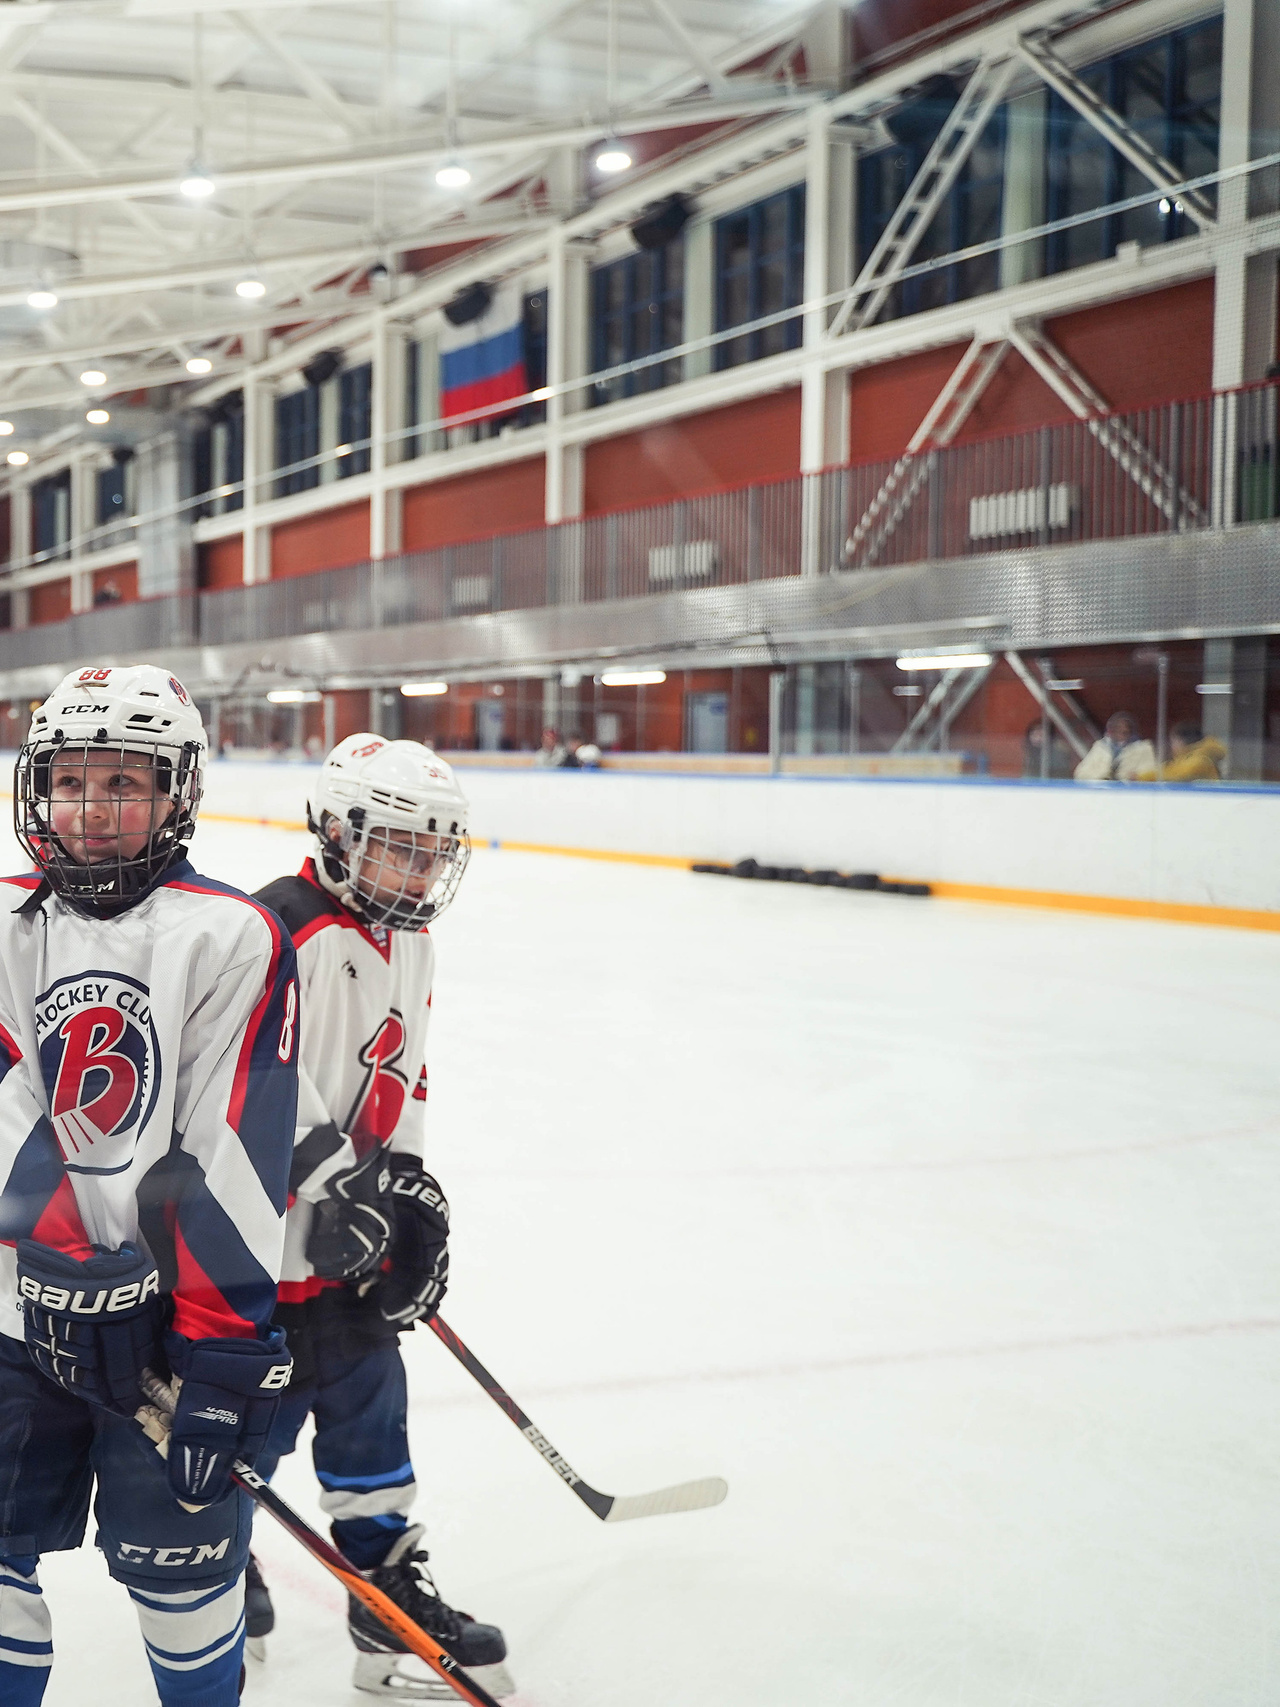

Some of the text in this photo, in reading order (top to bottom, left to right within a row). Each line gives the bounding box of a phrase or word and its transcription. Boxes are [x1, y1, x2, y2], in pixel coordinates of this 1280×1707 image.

[78, 669, 112, 681] 88
[61, 704, 110, 715] CCM
[35, 984, 110, 1036] HOCKEY
[20, 1268, 160, 1315] BAUER
[524, 1423, 581, 1487] BAUER
[116, 1538, 232, 1568] CCM
